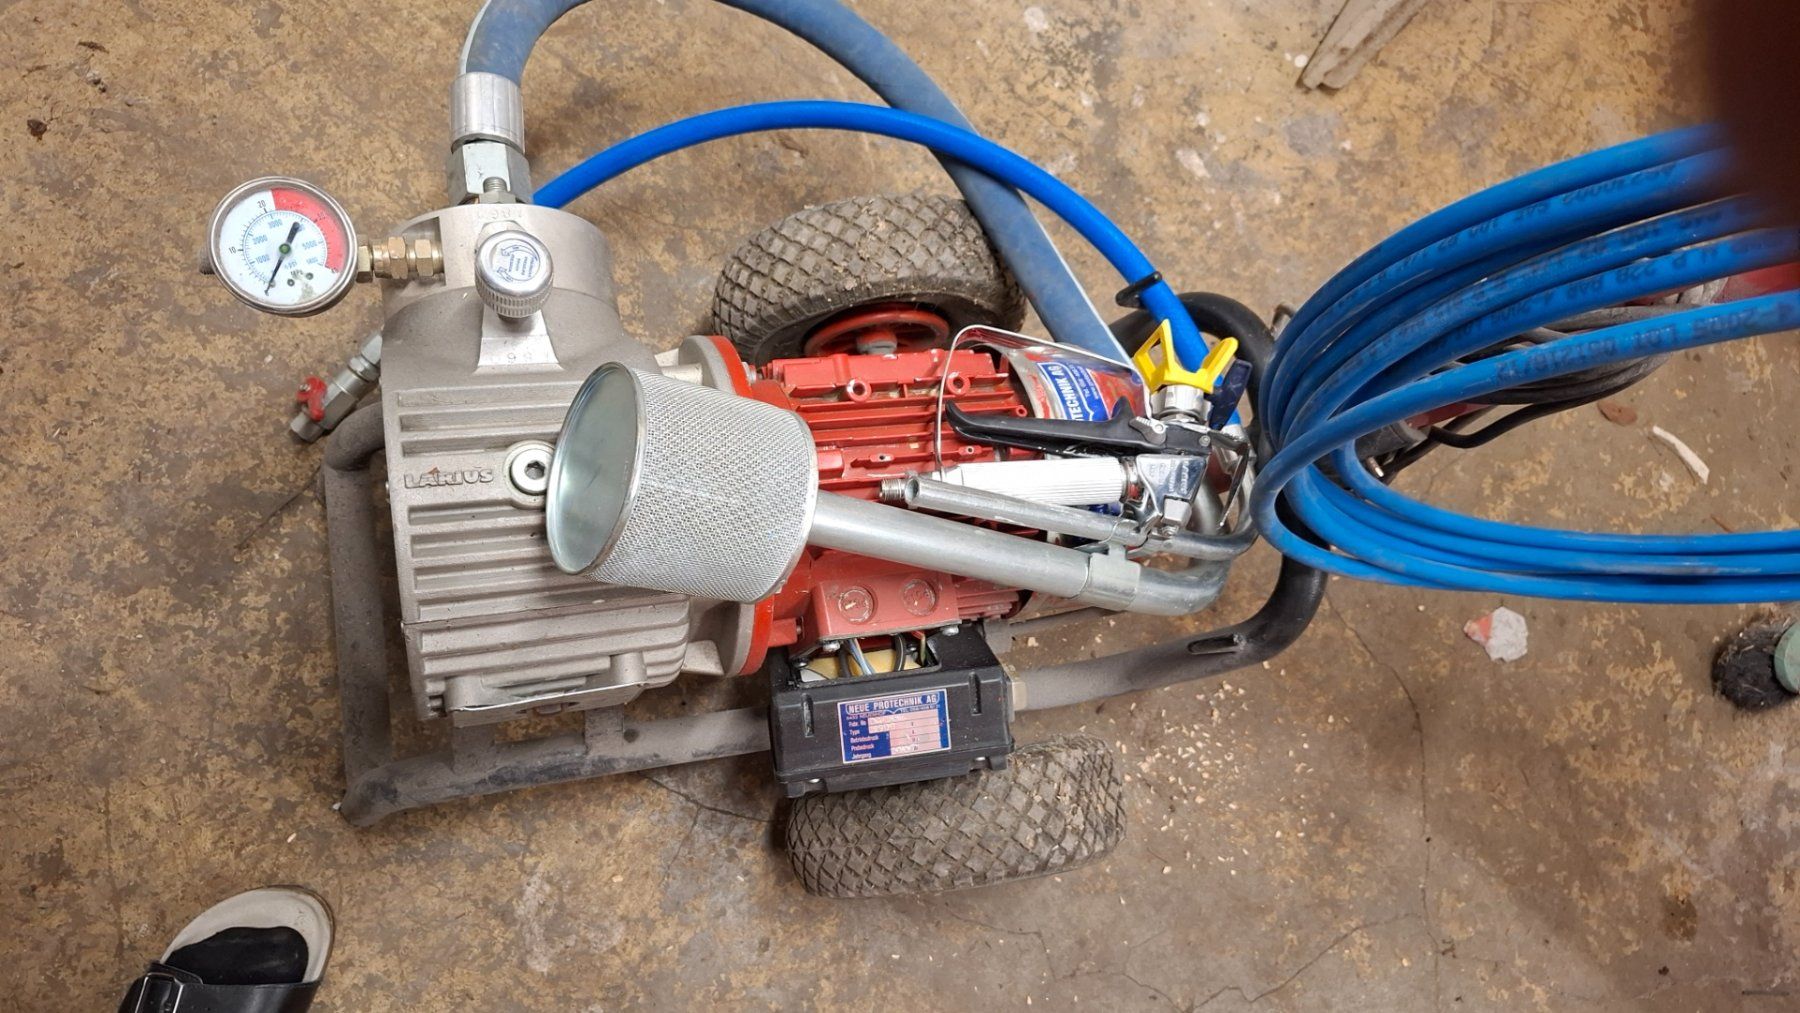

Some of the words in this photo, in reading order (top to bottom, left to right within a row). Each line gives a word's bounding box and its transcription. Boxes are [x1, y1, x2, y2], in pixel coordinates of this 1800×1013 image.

[256, 199, 267, 209] 20
[228, 246, 237, 254] 10
[255, 253, 270, 264] 1000
[1048, 365, 1065, 376] AG
[1055, 377, 1085, 421] TECHNIK
[404, 468, 494, 489] LARIUS
[849, 703, 870, 714] NEUE
[874, 696, 922, 710] PROTECHNIK
[926, 694, 937, 704] AG
